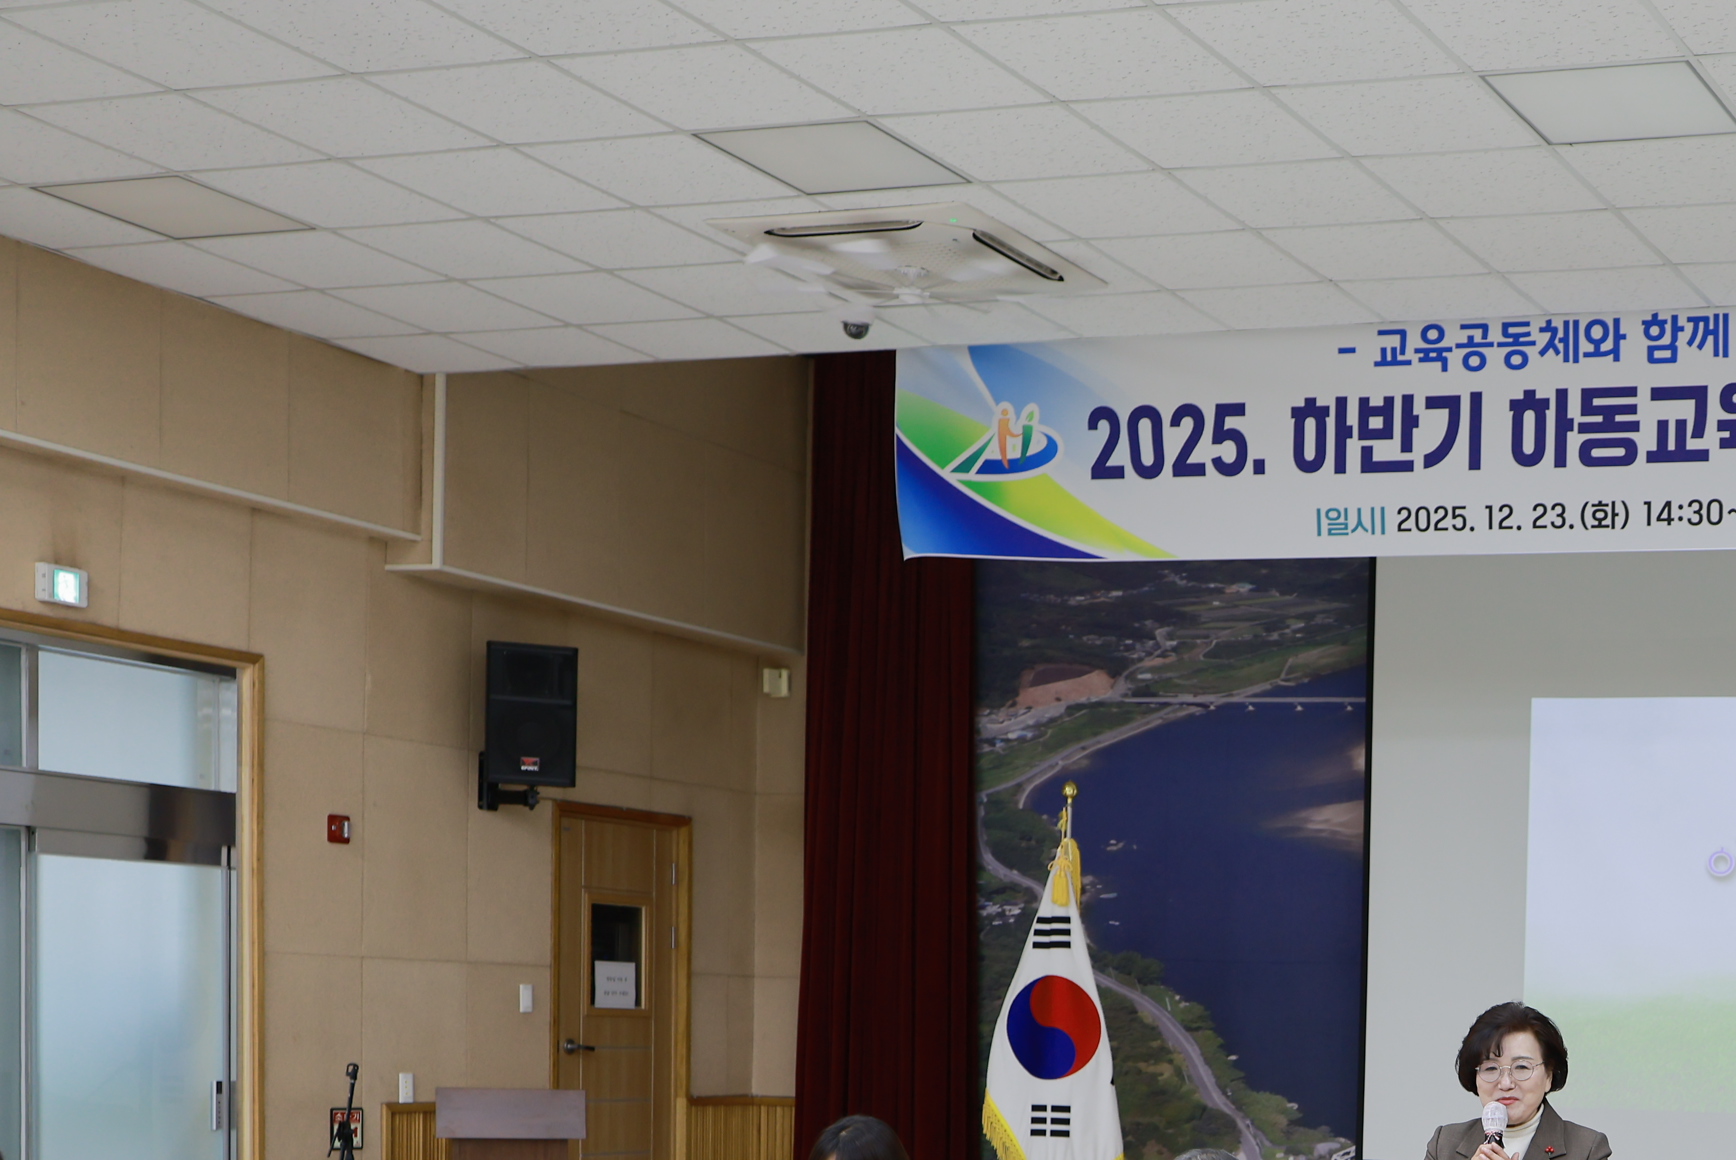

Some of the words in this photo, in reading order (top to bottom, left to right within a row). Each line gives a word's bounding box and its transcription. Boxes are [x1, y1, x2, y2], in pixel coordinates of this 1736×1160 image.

[1373, 316, 1627, 374] 교육공동체와
[1641, 311, 1730, 365] 함께
[1087, 402, 1266, 482] 2025.
[1290, 390, 1483, 475] 하반기
[1396, 504, 1475, 533] 2025.
[1484, 502, 1522, 531] 12.
